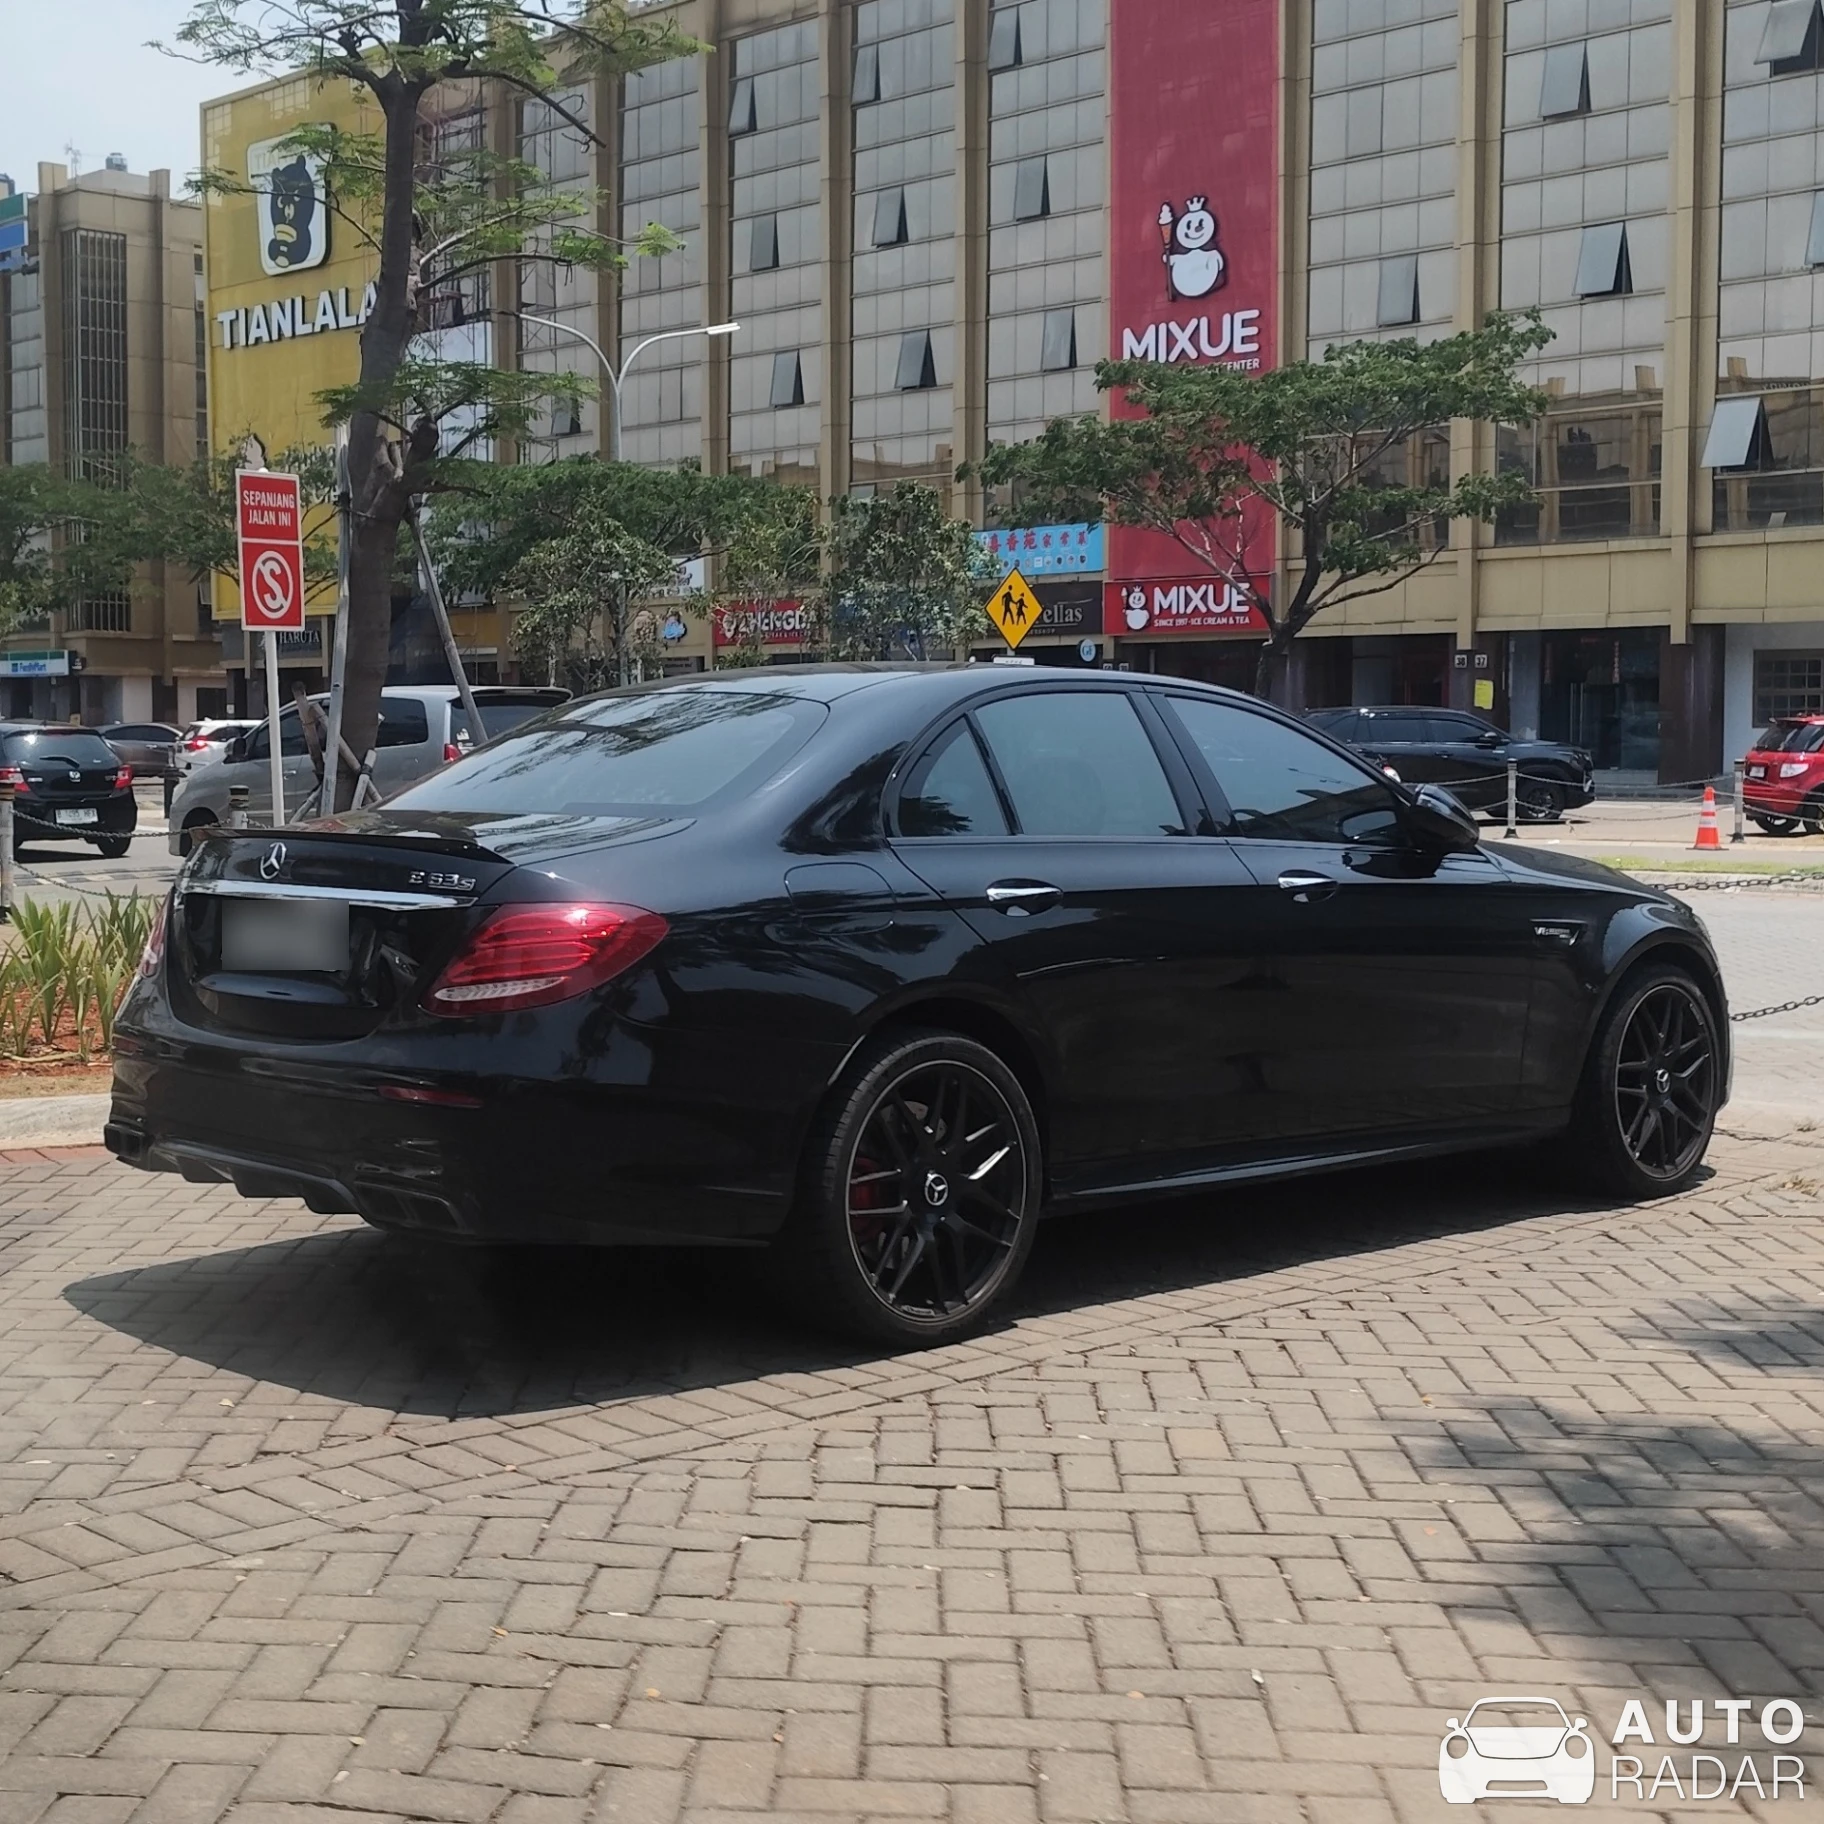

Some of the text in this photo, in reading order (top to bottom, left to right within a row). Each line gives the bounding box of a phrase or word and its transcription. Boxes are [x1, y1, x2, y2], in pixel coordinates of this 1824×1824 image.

[1123, 309, 1260, 363] MIXUE
[243, 490, 295, 508] SEPANJANG
[249, 510, 291, 526] JALAN INI
[1154, 583, 1250, 615] MIXUE
[1154, 619, 1173, 627] SINCE
[1203, 616, 1227, 625] CREAM
[1229, 616, 1234, 624] &
[1235, 615, 1250, 624] TEA
[1456, 656, 1486, 666] 38 37
